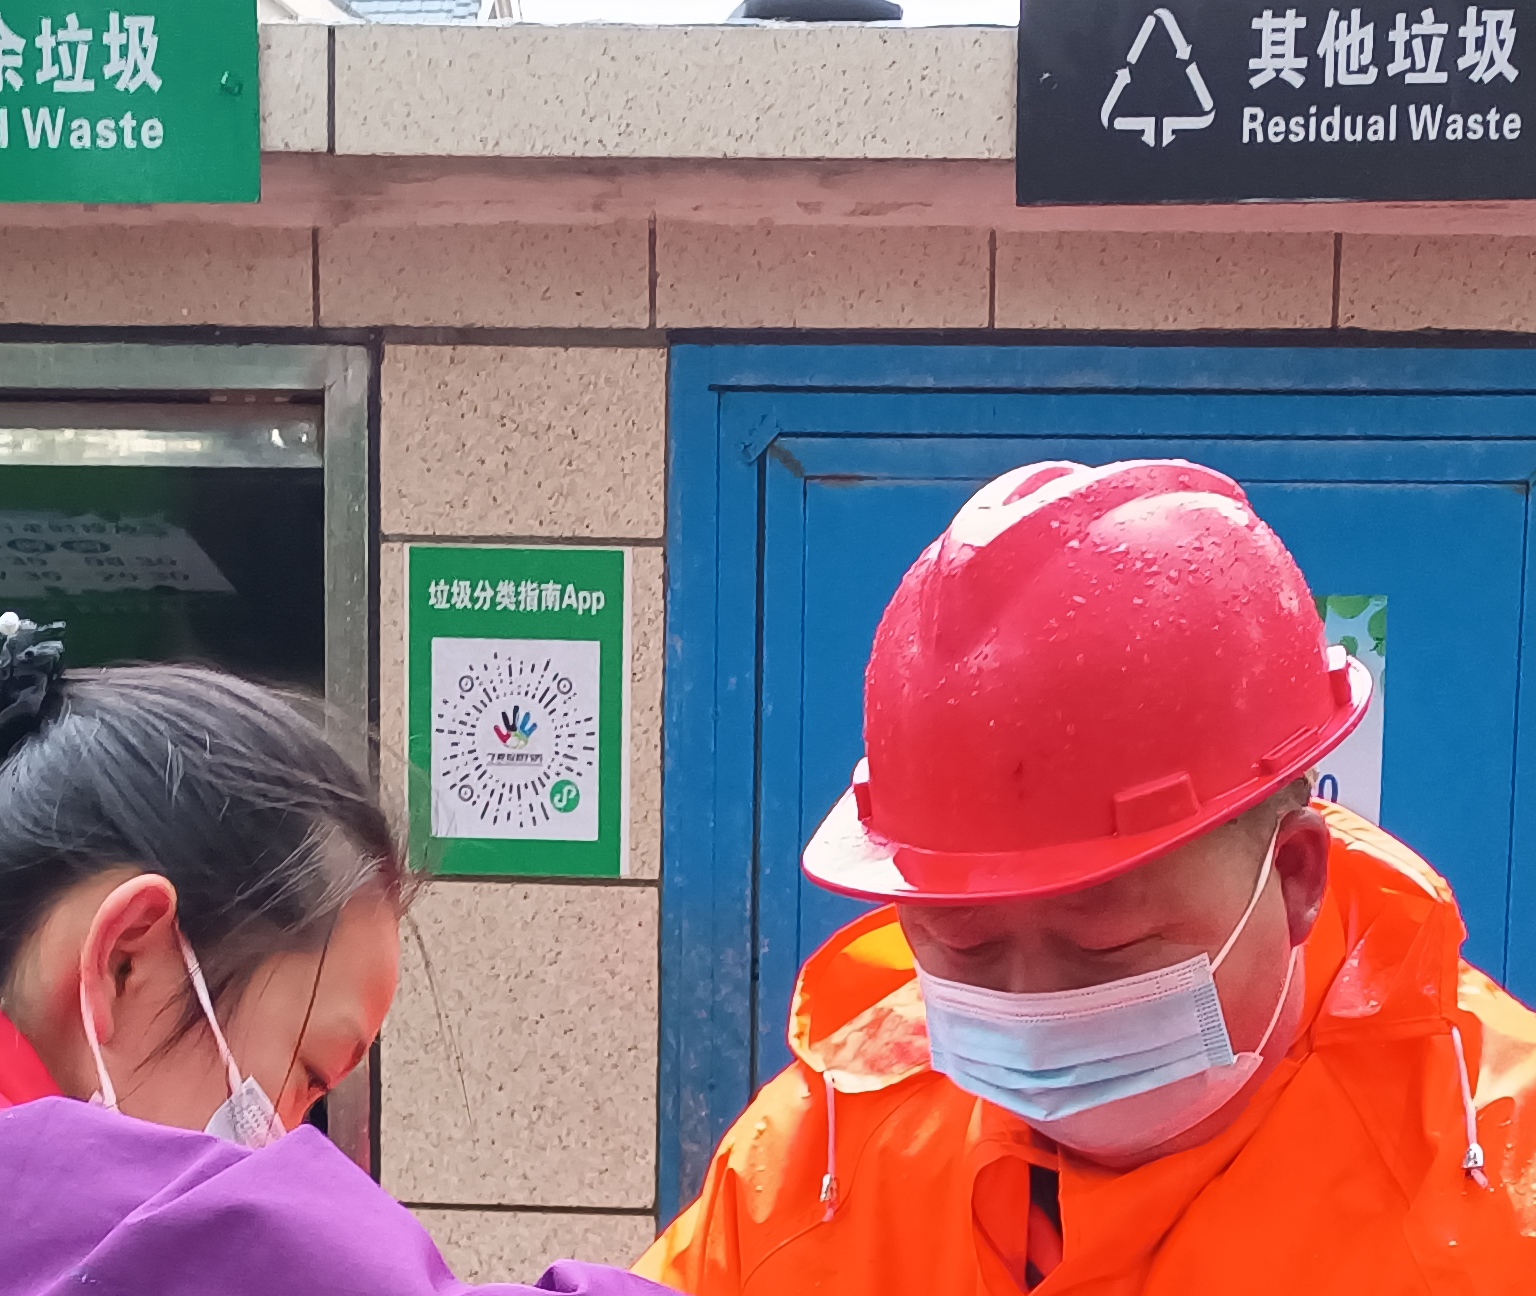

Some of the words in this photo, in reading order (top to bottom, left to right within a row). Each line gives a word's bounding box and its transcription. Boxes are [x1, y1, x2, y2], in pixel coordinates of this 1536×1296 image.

[1246, 6, 1521, 89] 其他垃圾
[22, 106, 165, 150] Waste
[1241, 105, 1398, 144] Residual
[1408, 104, 1522, 141] Waste
[428, 579, 606, 615] 垃圾分类指南App
